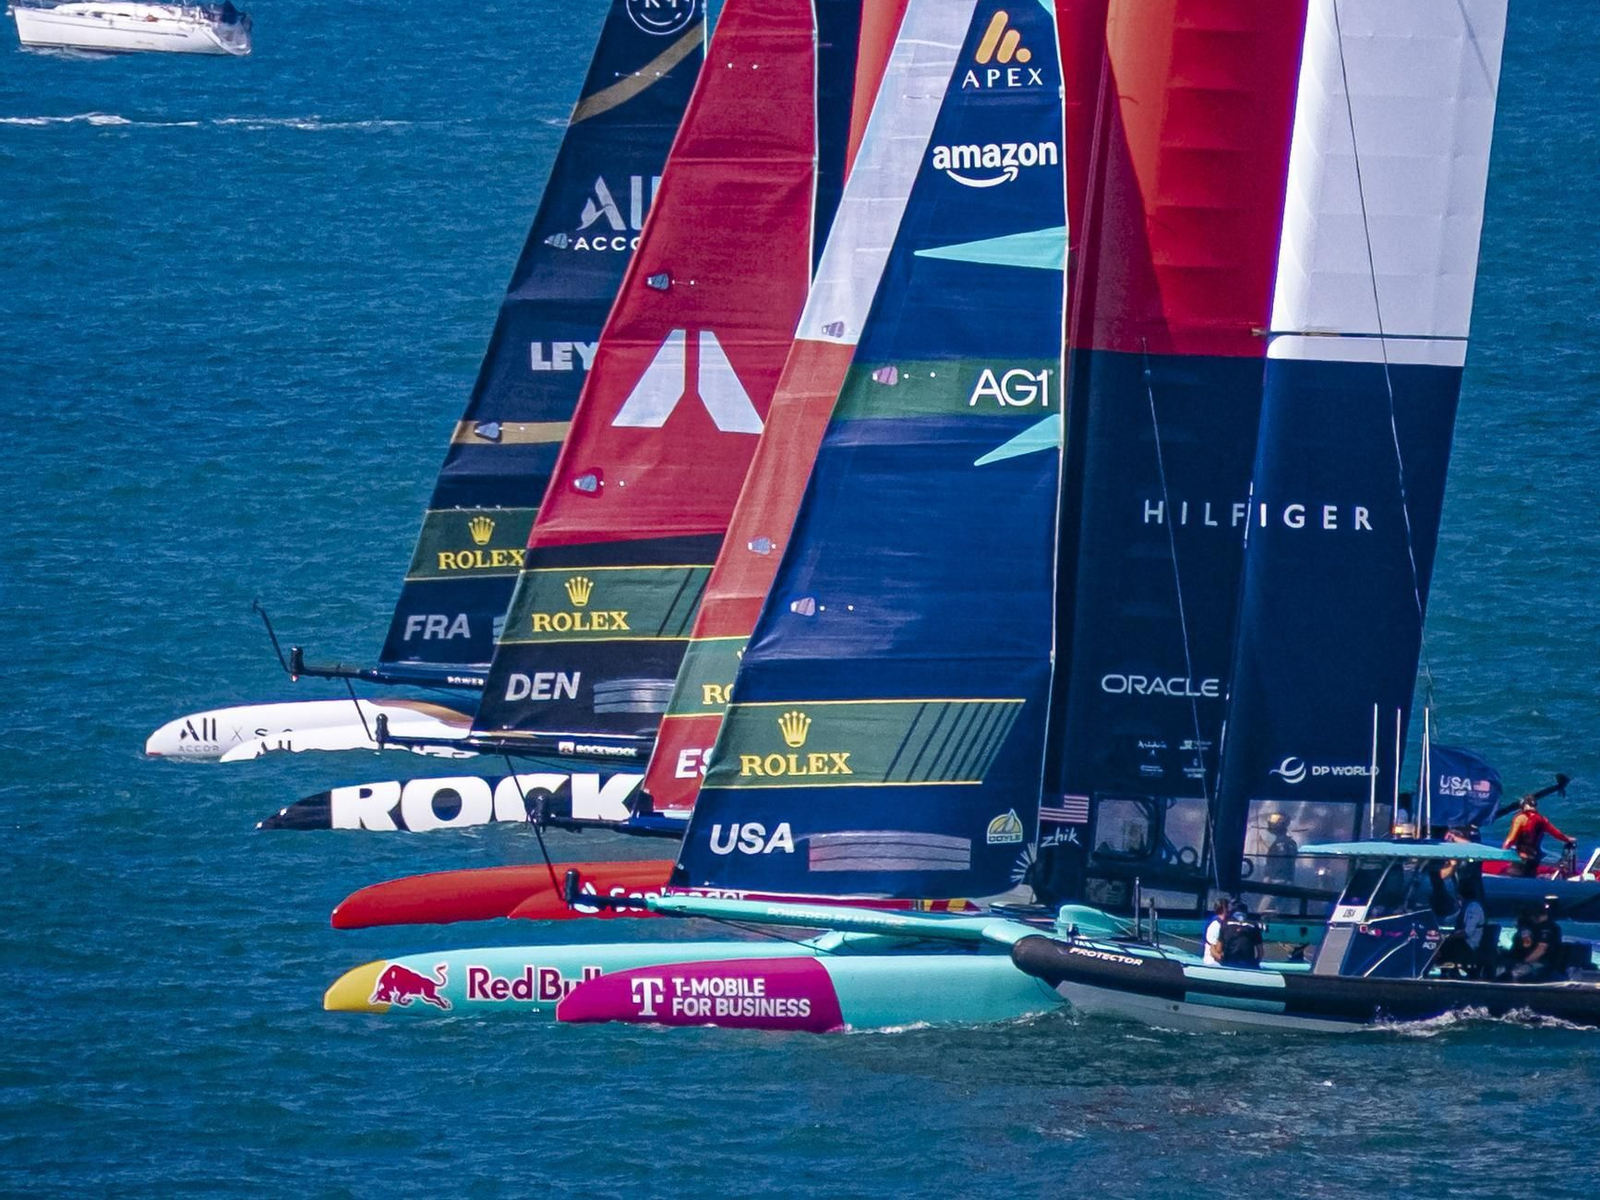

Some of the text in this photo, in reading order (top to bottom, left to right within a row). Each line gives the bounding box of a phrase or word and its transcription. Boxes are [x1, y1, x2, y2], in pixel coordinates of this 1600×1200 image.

[961, 67, 1044, 90] APEX
[932, 141, 1058, 170] amazon
[531, 341, 600, 371] LEY
[969, 368, 1049, 407] AG1
[1144, 499, 1373, 531] HILFIGER
[437, 549, 526, 570] ROLEX
[403, 613, 471, 642] FRA
[532, 611, 631, 633] ROLEX
[505, 671, 581, 701] DEN
[1101, 674, 1220, 697] ORACLE
[179, 745, 220, 753] ACCOR
[739, 752, 853, 777] ROLEX
[1311, 765, 1380, 776] DP WORLD
[1440, 774, 1472, 791] USA
[331, 773, 644, 832] ROCK
[710, 822, 795, 856] USA
[1040, 827, 1080, 848] zhik
[1069, 947, 1144, 966] PROTECTOR
[466, 965, 534, 1001] Red
[671, 978, 766, 997] T-MOBILE
[672, 998, 811, 1017] FOR BUSINESS
